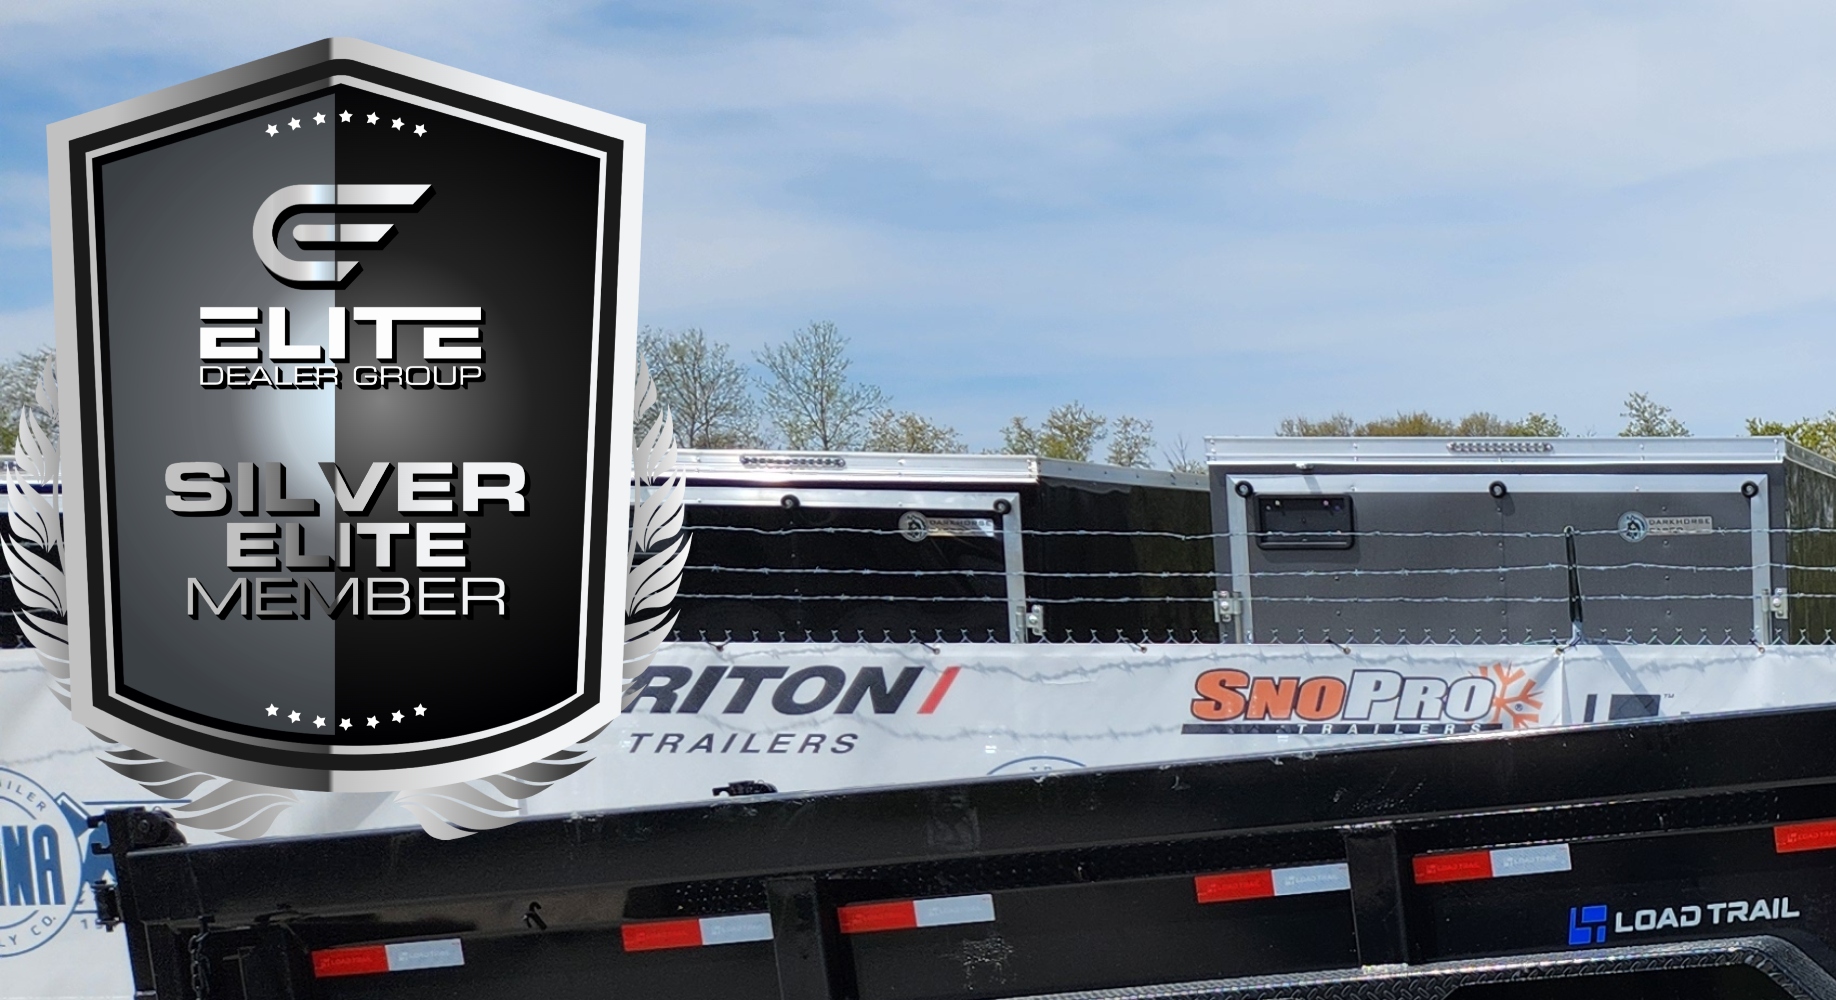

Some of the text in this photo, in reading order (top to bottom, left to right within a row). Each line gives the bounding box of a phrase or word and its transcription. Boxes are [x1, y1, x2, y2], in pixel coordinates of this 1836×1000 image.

[1298, 723, 1482, 735] TRAILERS
[628, 733, 860, 754] TRAILERS
[1615, 896, 1801, 933] LOAD TRAIL
